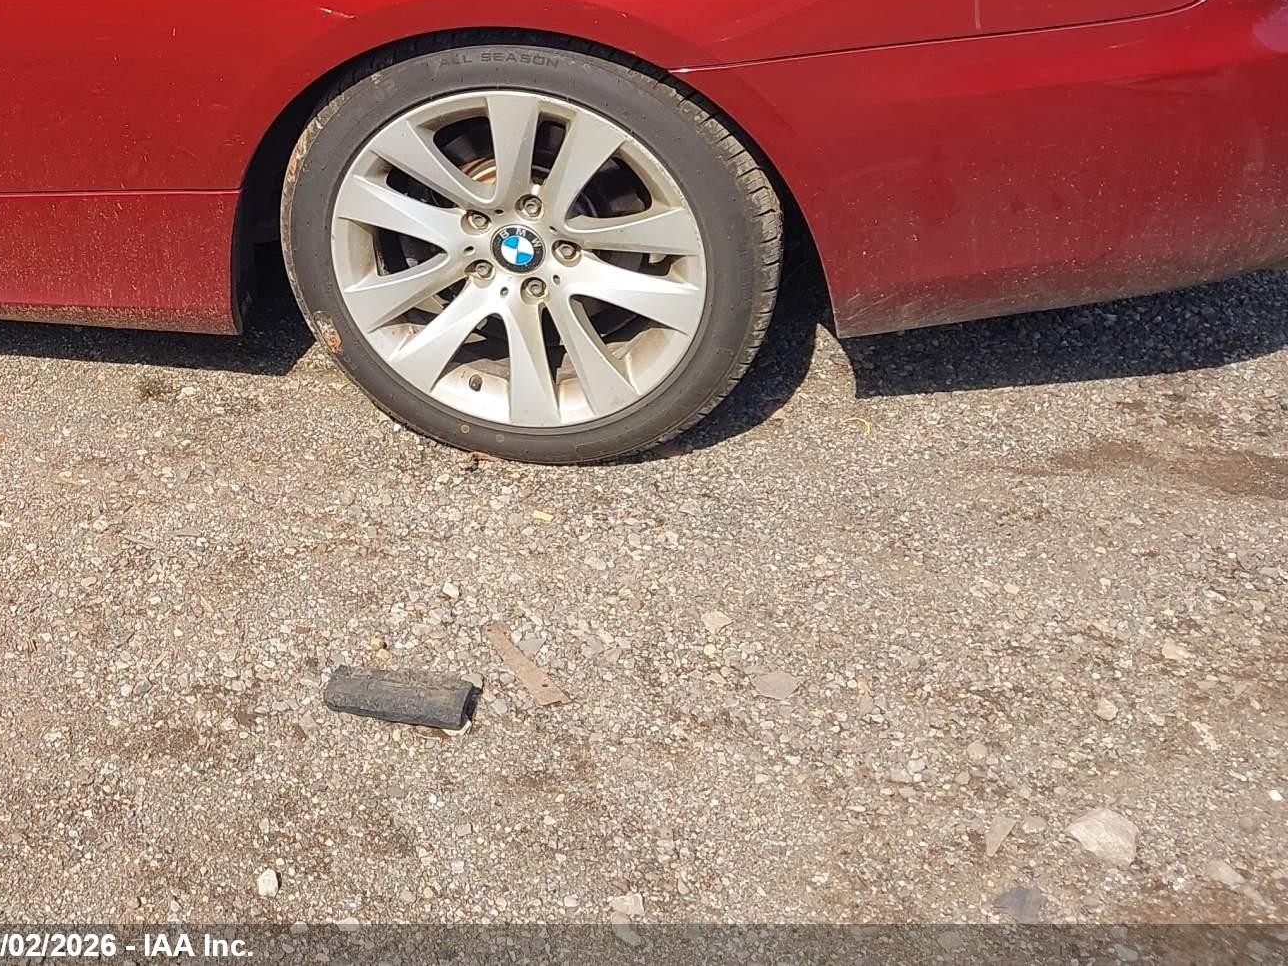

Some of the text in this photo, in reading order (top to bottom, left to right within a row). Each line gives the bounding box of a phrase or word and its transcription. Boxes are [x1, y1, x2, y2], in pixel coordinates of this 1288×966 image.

[439, 52, 560, 69] ALL SEASON
[499, 228, 542, 248] BMW
